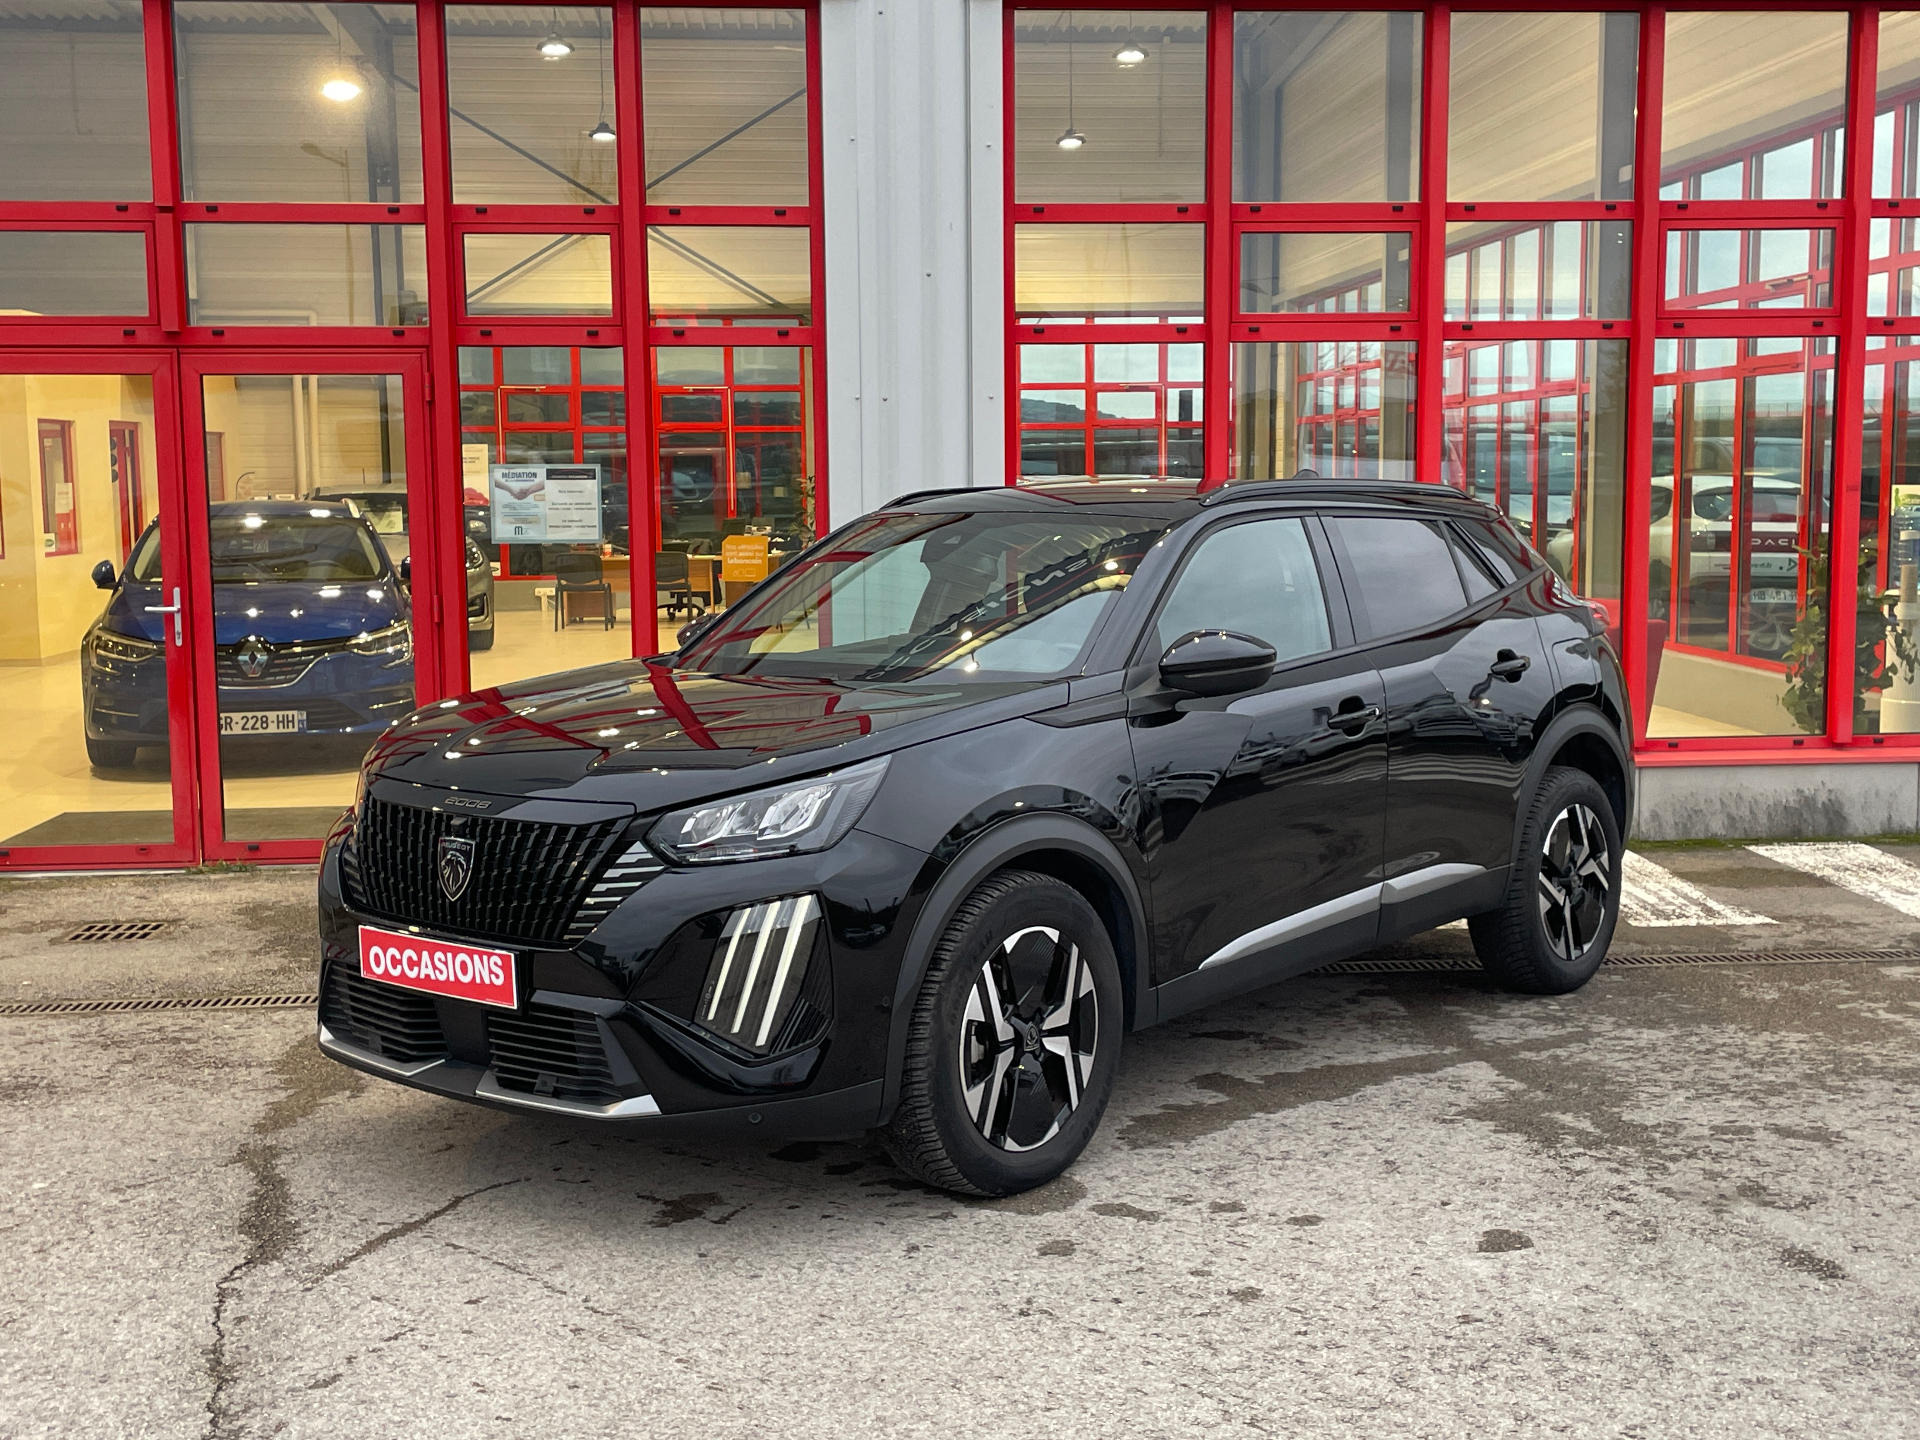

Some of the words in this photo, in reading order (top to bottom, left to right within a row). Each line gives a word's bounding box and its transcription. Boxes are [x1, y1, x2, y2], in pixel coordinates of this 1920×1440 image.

[502, 470, 537, 479] MÉDIATION
[445, 796, 492, 809] 2008
[441, 841, 471, 852] PEUGEOT
[369, 945, 505, 987] OCCASIONS
